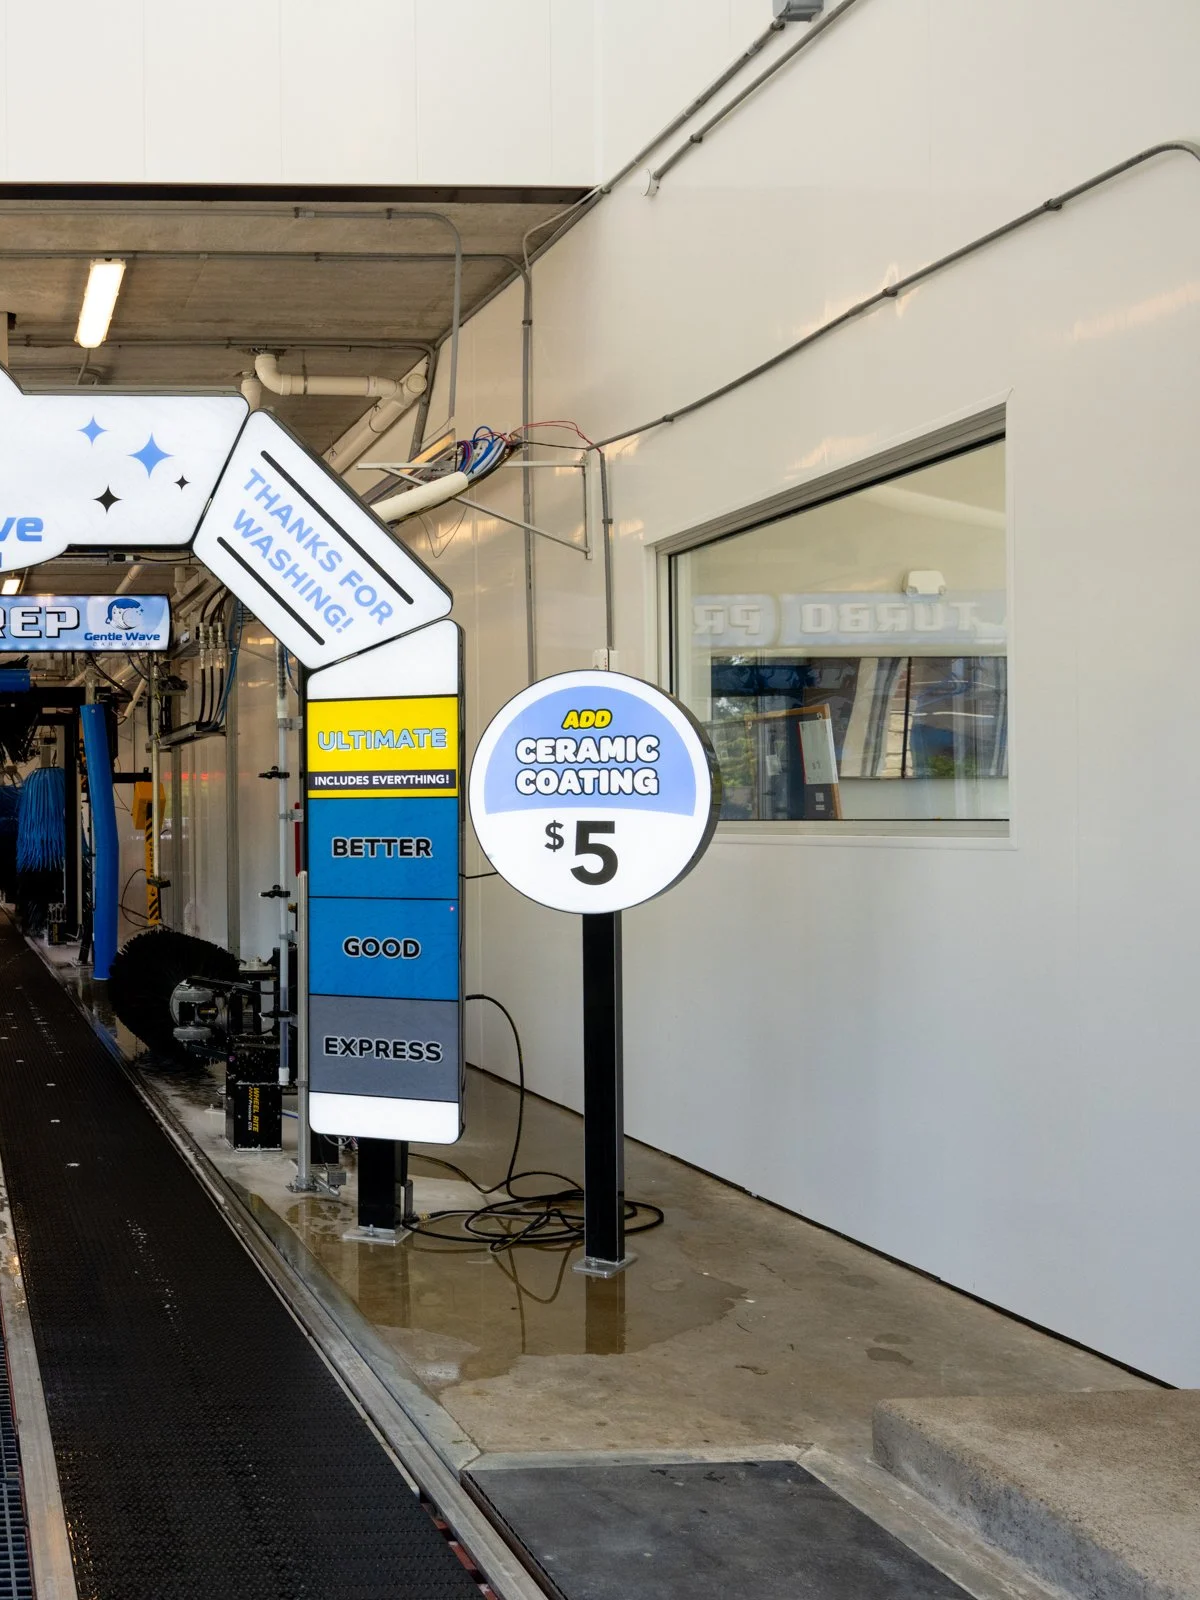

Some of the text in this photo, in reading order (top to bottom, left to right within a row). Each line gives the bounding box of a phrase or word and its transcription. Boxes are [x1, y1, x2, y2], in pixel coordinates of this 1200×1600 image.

[243, 467, 394, 626] THANKS FOR
[232, 508, 354, 634] WASHING!
[84, 632, 161, 641] Gentle Wave
[561, 708, 612, 730] ADD
[317, 727, 449, 752] ULTIMATE
[515, 735, 660, 765] CERAMIC
[314, 774, 450, 786] INCLUDES EVERYTHING!
[515, 767, 660, 796] COATING
[331, 837, 433, 859] BETTER
[342, 936, 422, 960] GOOD
[322, 1036, 443, 1063] EXPRESS
